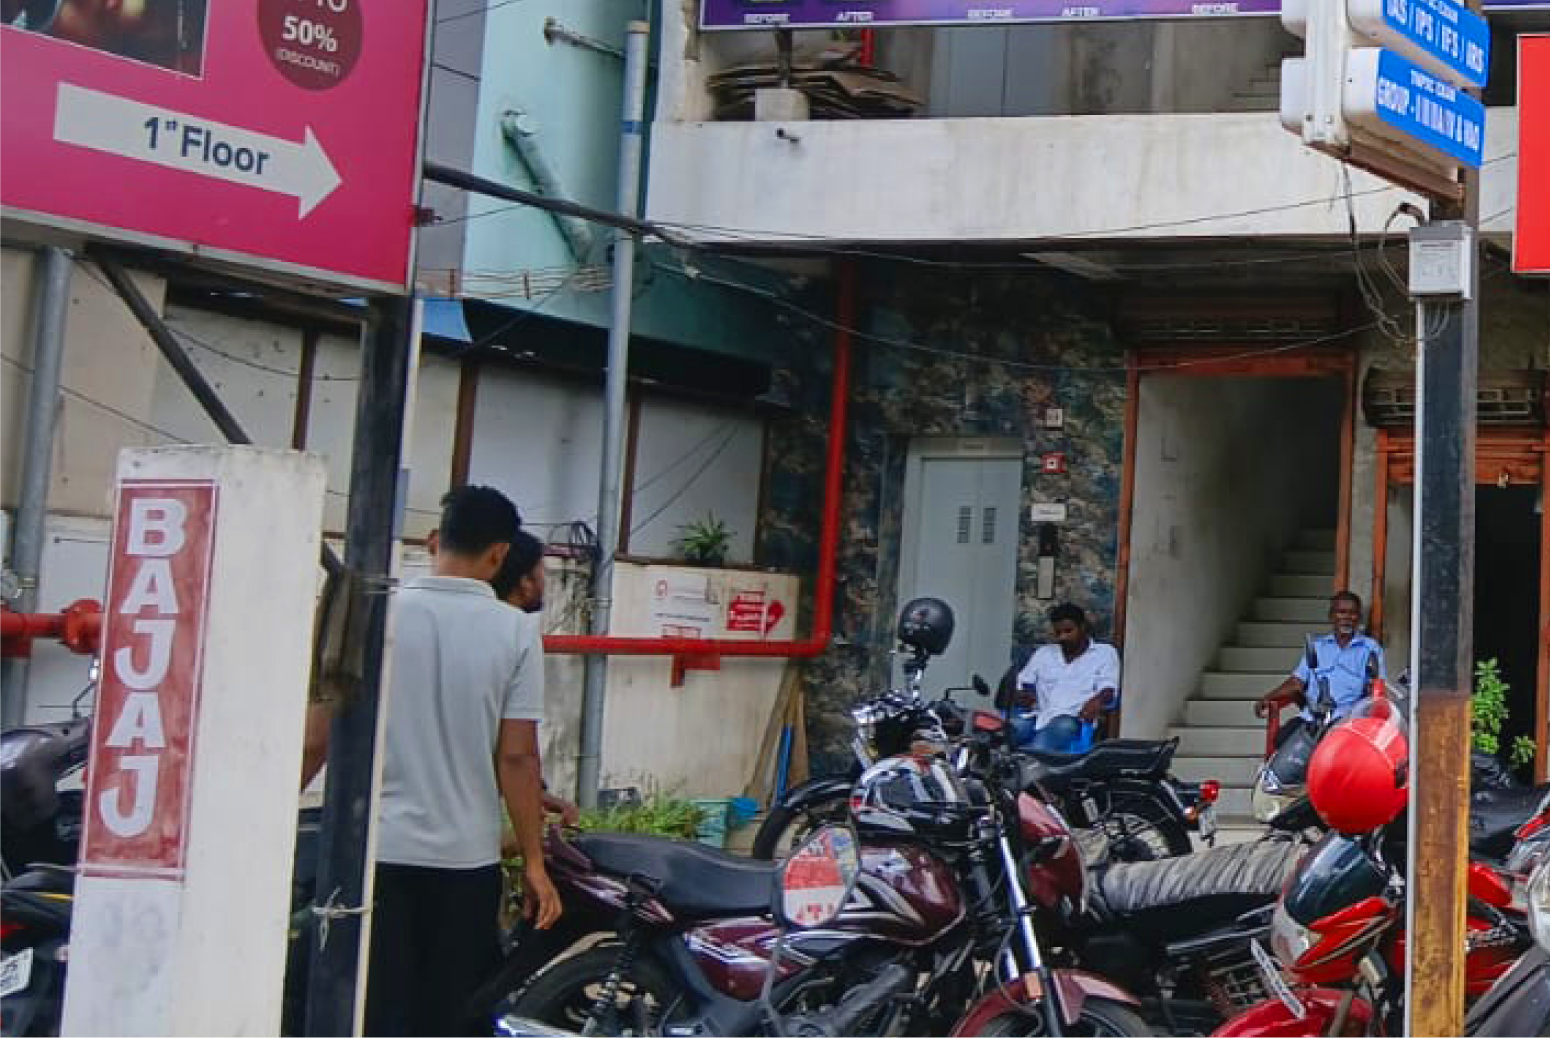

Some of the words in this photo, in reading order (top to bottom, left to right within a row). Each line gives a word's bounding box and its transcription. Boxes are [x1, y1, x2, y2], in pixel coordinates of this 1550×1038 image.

[282, 15, 338, 52] 50%
[180, 124, 270, 176] Floor
[99, 497, 189, 839] BAJAJ
